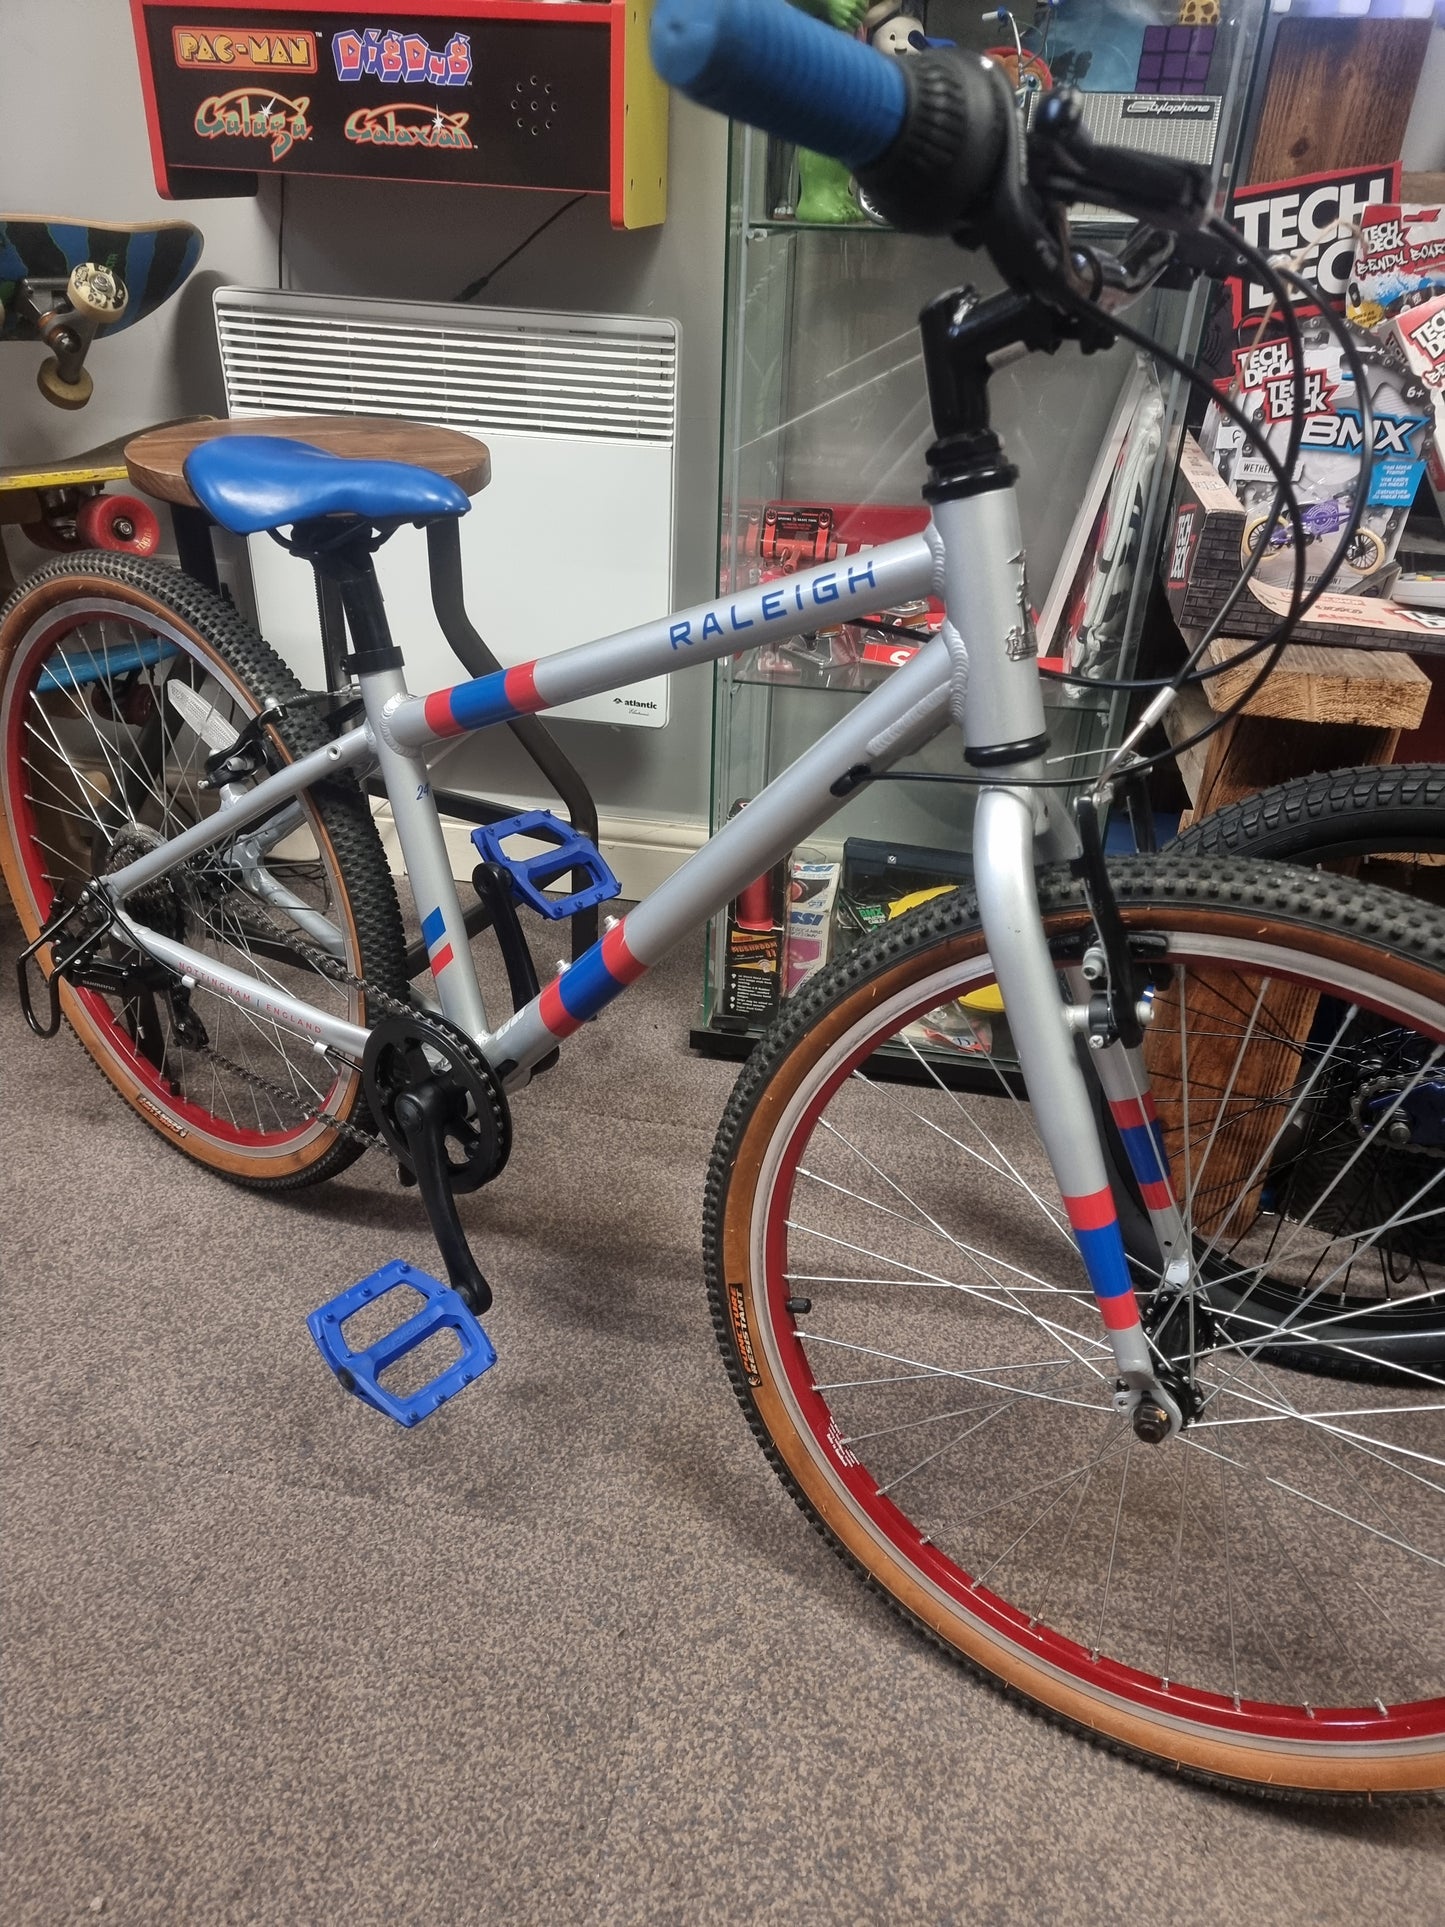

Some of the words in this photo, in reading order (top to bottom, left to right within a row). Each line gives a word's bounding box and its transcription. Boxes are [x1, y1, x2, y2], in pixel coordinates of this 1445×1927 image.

[177, 32, 311, 65] PAC-MAN
[195, 87, 313, 162] Galaga
[1126, 100, 1211, 115] Stylophone
[344, 103, 473, 148] Galaxian
[1234, 178, 1385, 250] TECH
[1362, 220, 1399, 243] TECH
[1367, 231, 1405, 255] DECK
[1237, 342, 1288, 372] TECH
[1406, 386, 1425, 398] 6+
[1300, 415, 1415, 452] BMX
[1243, 463, 1273, 474] WETHE
[669, 560, 876, 650] RALEIGH
[624, 699, 657, 710] atlantic
[178, 961, 251, 1002] NOTTINGHAM
[265, 1003, 323, 1035] ENGLAND
[729, 1286, 752, 1374] PUNCTURE
[737, 1290, 758, 1375] RESISTANT
